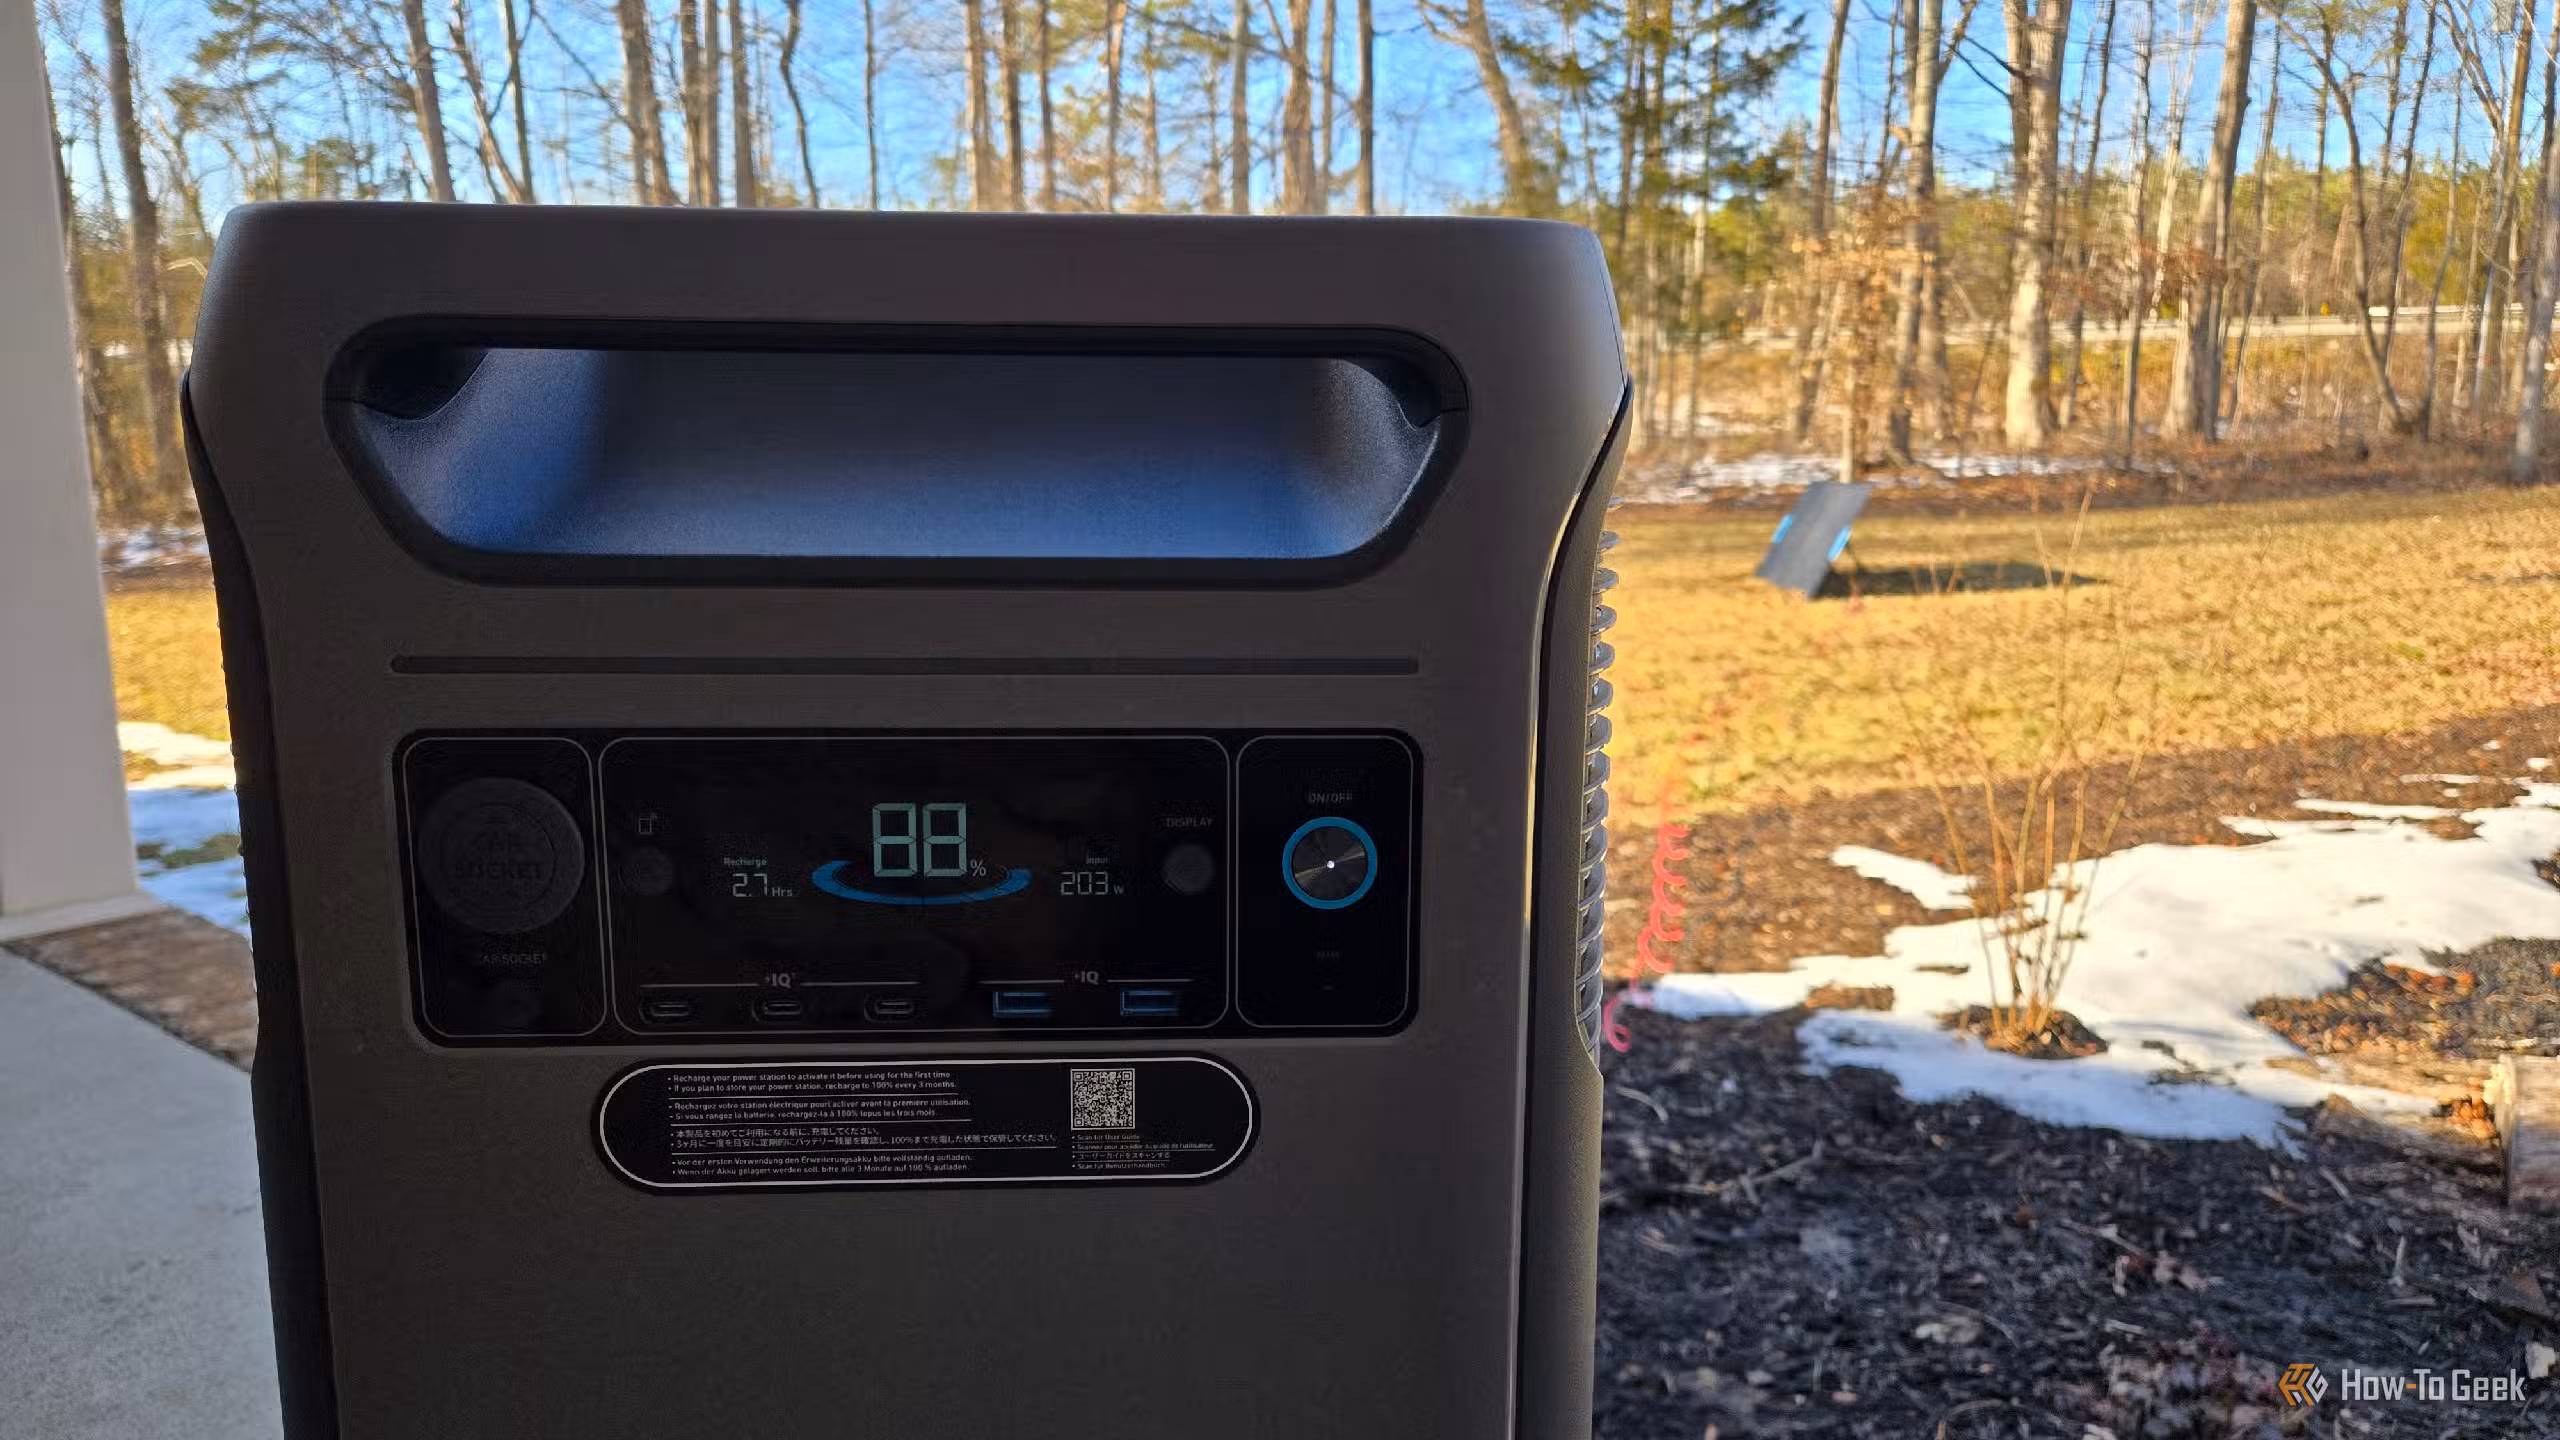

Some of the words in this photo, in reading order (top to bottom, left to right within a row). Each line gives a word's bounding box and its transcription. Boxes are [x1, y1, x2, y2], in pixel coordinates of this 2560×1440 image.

[1309, 792, 1354, 804] ON/OFF
[1165, 816, 1215, 829] DISPLAY
[871, 801, 968, 878] 88
[969, 859, 988, 878] %
[723, 857, 769, 869] Recharge
[1085, 856, 1110, 867] Input
[732, 872, 768, 898] 2.7
[771, 886, 793, 898] Hrs
[1059, 871, 1110, 896] 203
[673, 1074, 711, 1084] Recharge
[712, 1075, 731, 1083] your
[732, 1075, 758, 1083] power
[759, 1073, 786, 1081] station
[787, 1072, 796, 1080] to
[797, 1072, 829, 1080] activate
[837, 1071, 862, 1080] before
[864, 1071, 886, 1081] using
[886, 1071, 898, 1079] for
[899, 1071, 914, 1079] the
[914, 1070, 932, 1079] first
[681, 1085, 696, 1094] you
[697, 1083, 716, 1093] plan
[716, 1083, 724, 1091] to
[726, 1083, 748, 1091] store
[748, 1084, 766, 1093] your
[767, 1084, 793, 1093] power
[825, 1082, 860, 1092] recharge
[861, 1081, 870, 1089] to
[871, 1081, 894, 1089] 100%
[894, 1082, 917, 1091] every
[918, 1081, 924, 1089] 3
[924, 1080, 957, 1088] months.
[674, 1101, 717, 1112] Rechargez
[718, 1101, 739, 1109] votre
[740, 1101, 768, 1109] station
[768, 1100, 809, 1110] électrique
[860, 1099, 882, 1107] avant
[883, 1099, 892, 1107] la
[705, 1113, 734, 1121] rangez
[734, 1111, 742, 1119] la
[1093, 1133, 1104, 1141] for
[691, 1157, 706, 1165] der
[707, 1157, 733, 1165] ersten
[734, 1156, 784, 1167] Verwendung
[785, 1156, 800, 1164] den
[873, 1154, 891, 1162] bitte
[716, 1166, 737, 1174] Akku
[772, 1165, 802, 1173] werden
[821, 1164, 839, 1173] bitte
[840, 1164, 855, 1172] alle
[893, 1163, 907, 1171] auf
